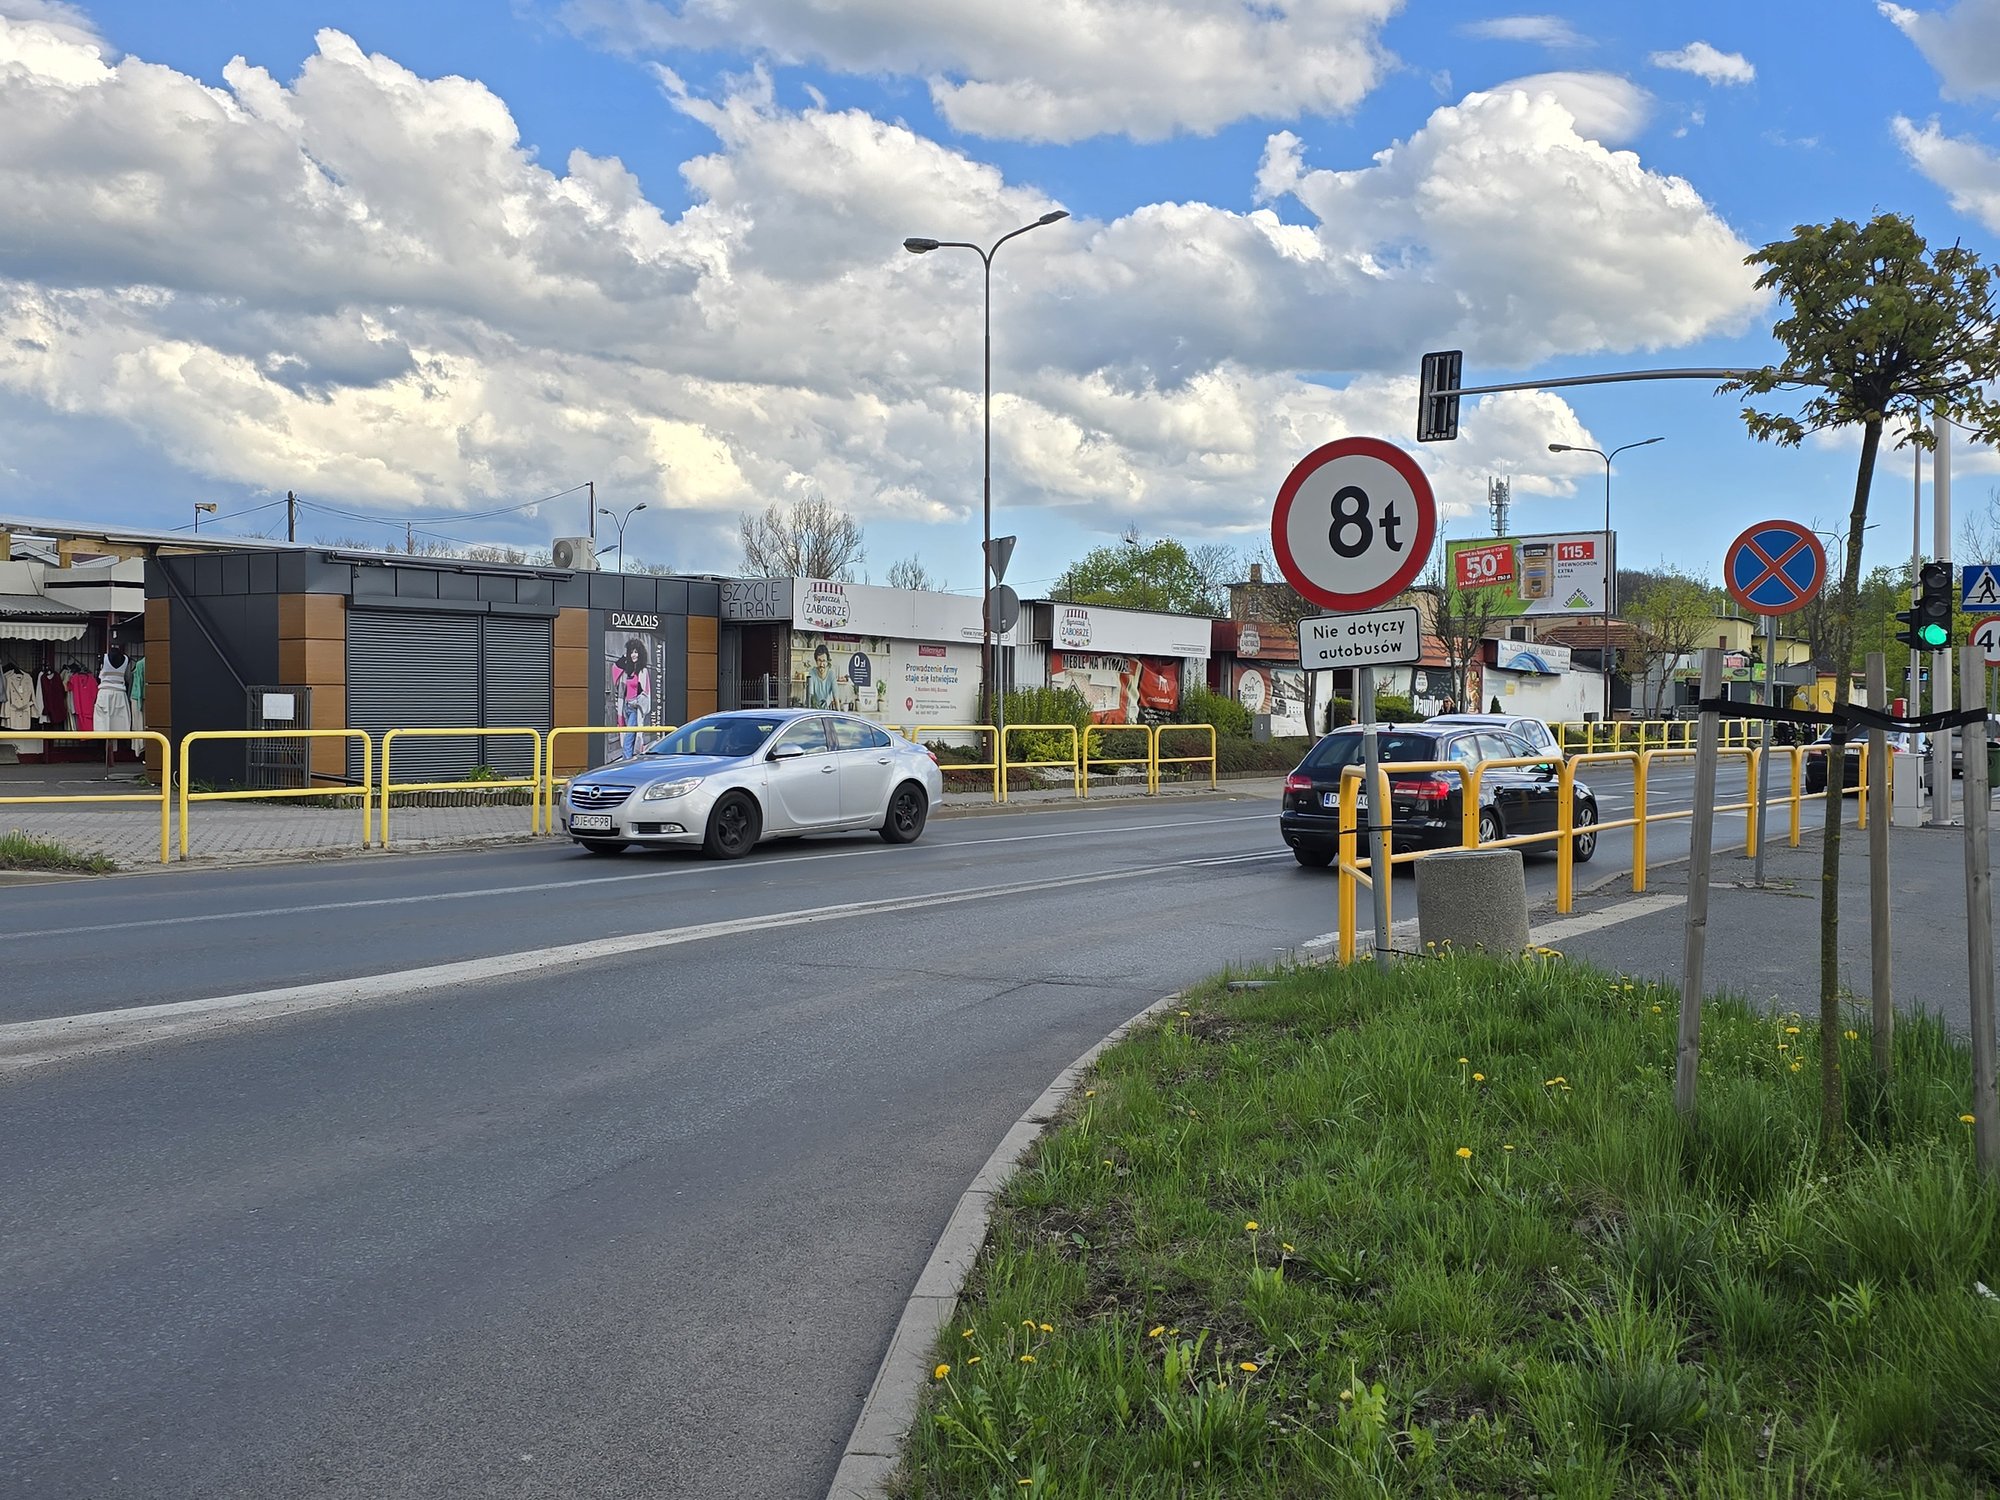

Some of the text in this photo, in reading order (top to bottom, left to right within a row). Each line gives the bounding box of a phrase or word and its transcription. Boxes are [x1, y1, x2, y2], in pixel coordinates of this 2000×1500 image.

[1466, 553, 1498, 579] 50
[721, 581, 782, 602] SZYCIE
[1563, 587, 1595, 608] LEROY MERLIN
[729, 601, 776, 618] FIRAN
[805, 603, 847, 617] ZABOBRZE
[611, 613, 659, 627] DAKARIS
[1061, 627, 1089, 637] ZABOBRZE
[1313, 619, 1406, 640] Nie dotyczy
[1976, 629, 2000, 653] 4
[1319, 640, 1403, 660] autobusów
[906, 663, 958, 675] Prowadzenie firmy
[1062, 654, 1086, 668] MEBLE
[1089, 655, 1099, 669] NA
[905, 673, 958, 685] staje się łatwiejsze
[575, 816, 609, 827] DJE CP98
